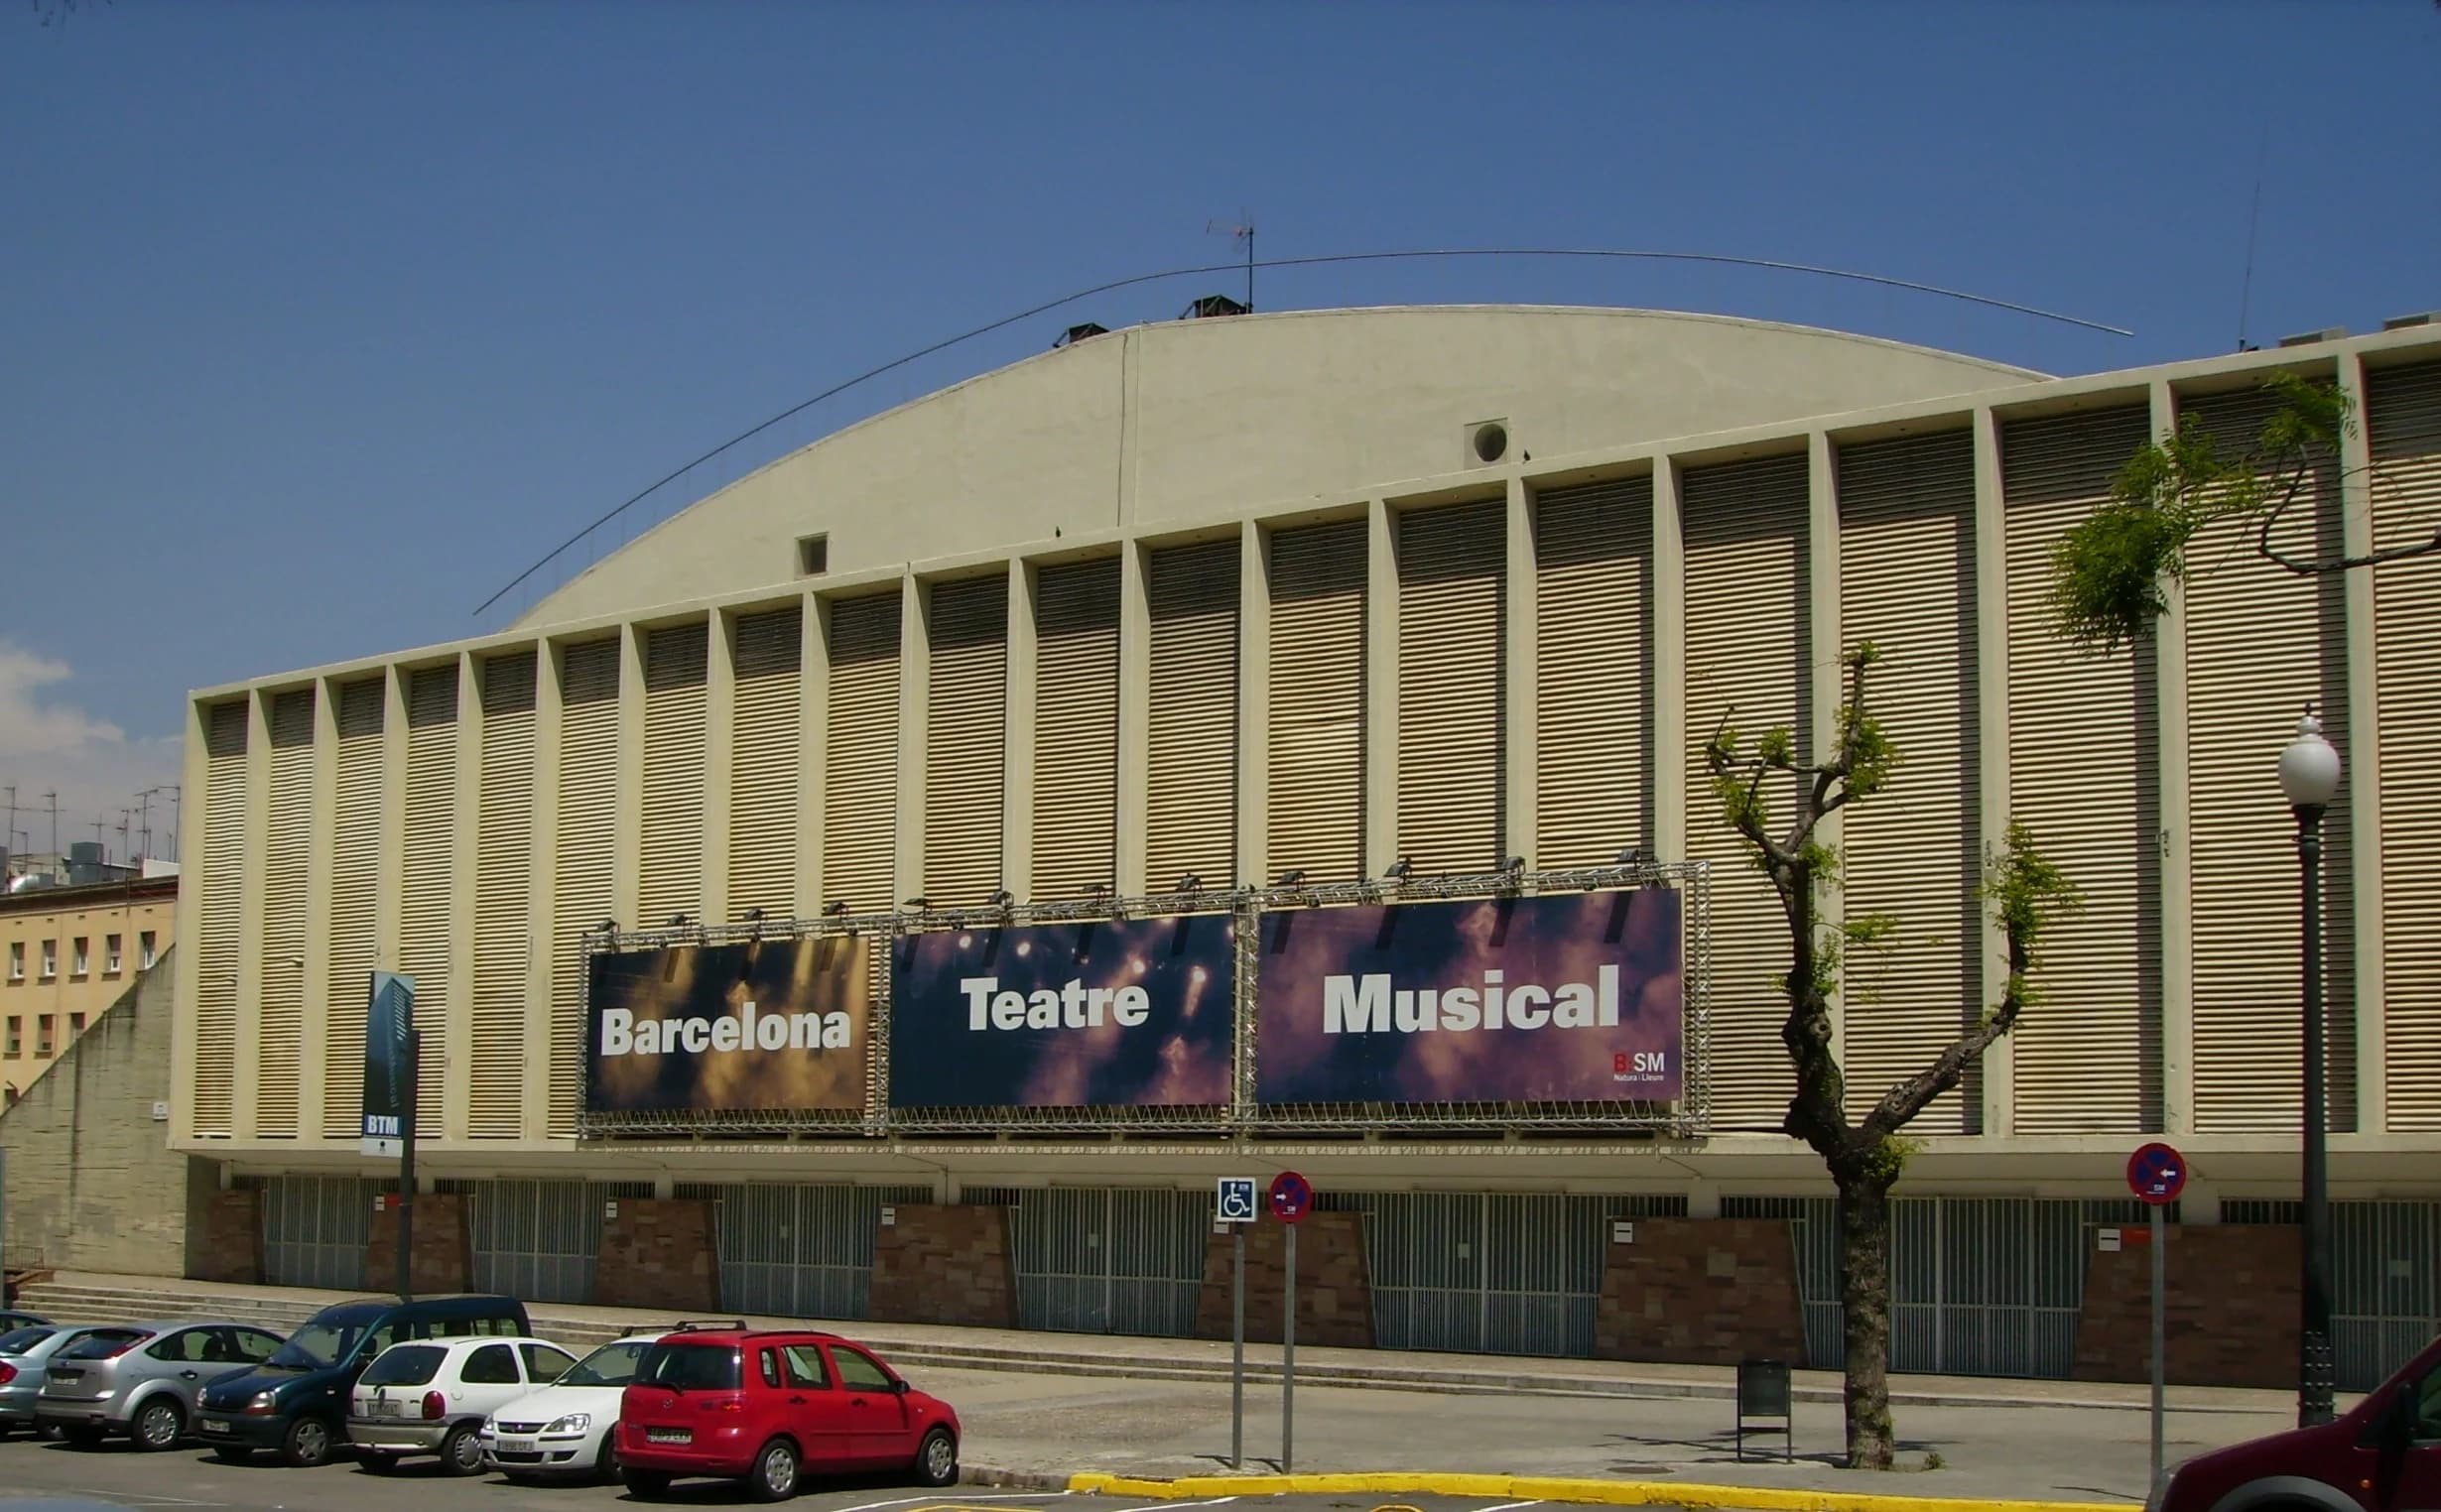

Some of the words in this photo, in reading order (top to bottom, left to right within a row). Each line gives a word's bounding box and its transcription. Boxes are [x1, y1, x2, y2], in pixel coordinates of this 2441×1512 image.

[600, 1001, 851, 1056] Barcelona
[961, 976, 1150, 1031] Teatre
[1324, 964, 1619, 1034] Musical
[367, 1114, 399, 1135] BTM
